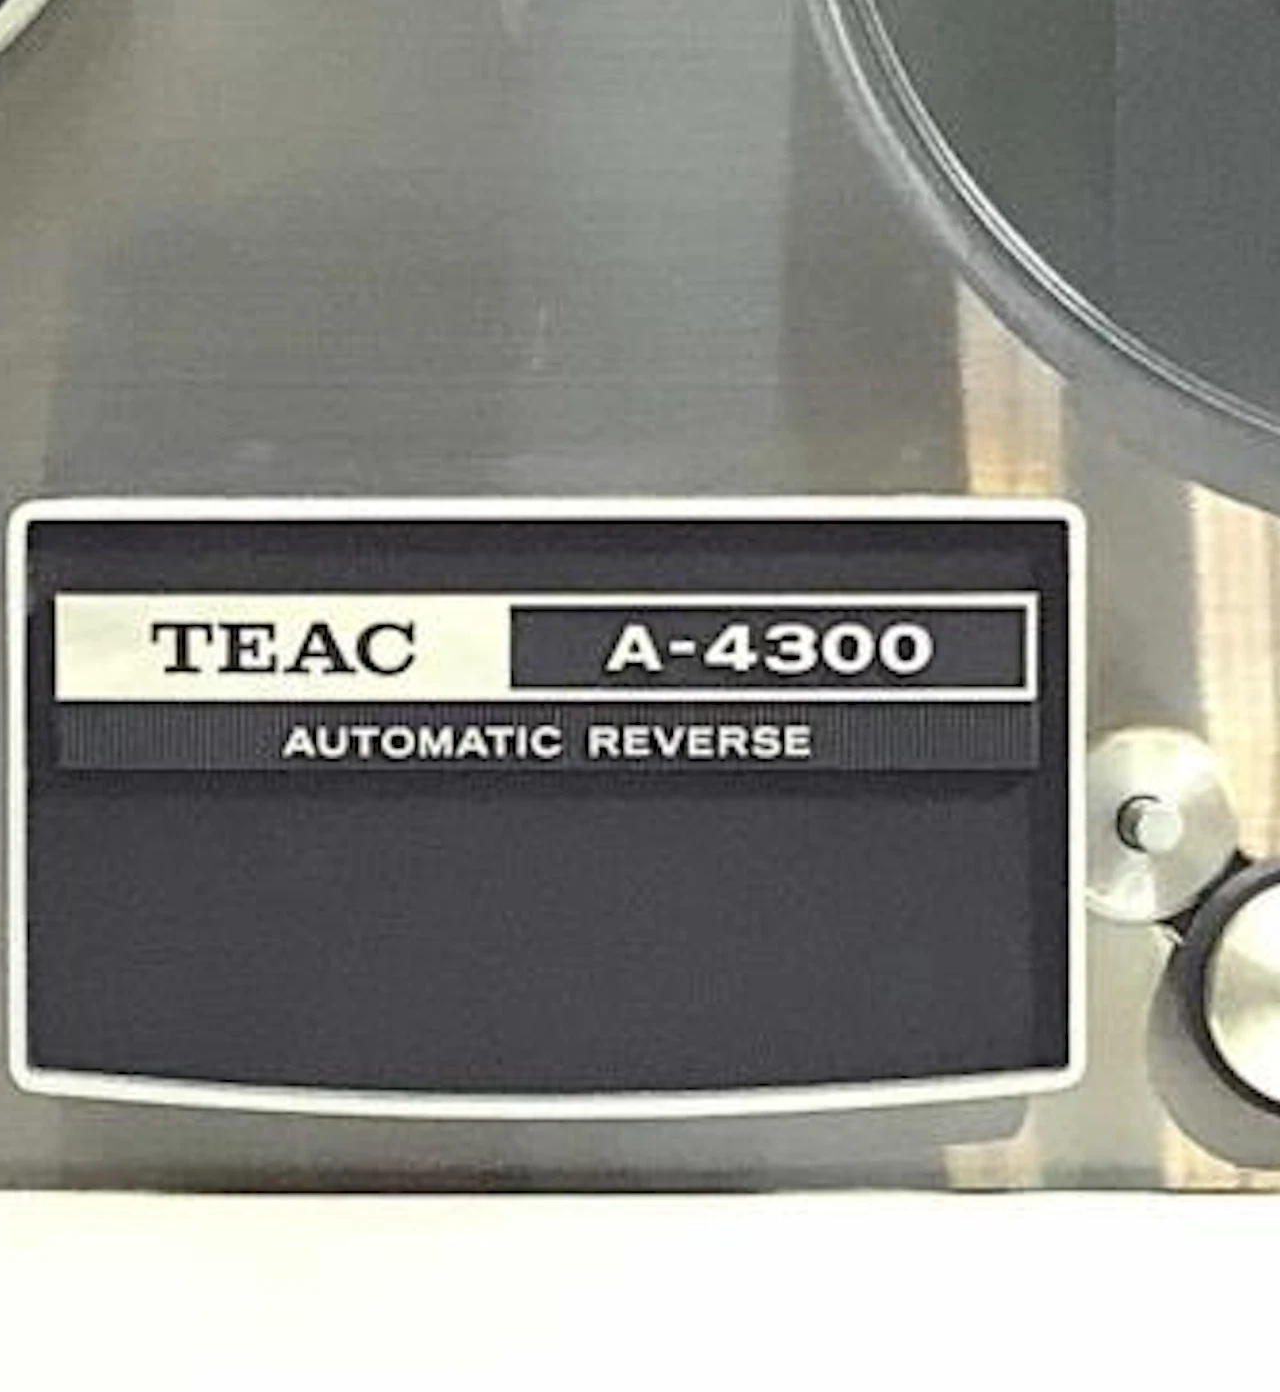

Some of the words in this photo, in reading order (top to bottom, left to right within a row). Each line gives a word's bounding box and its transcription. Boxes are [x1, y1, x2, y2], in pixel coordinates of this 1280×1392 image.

[152, 622, 415, 677] TEAC
[606, 623, 933, 674] A-4300
[282, 723, 562, 760] AUTOMATIC
[589, 724, 811, 759] REVERSE
